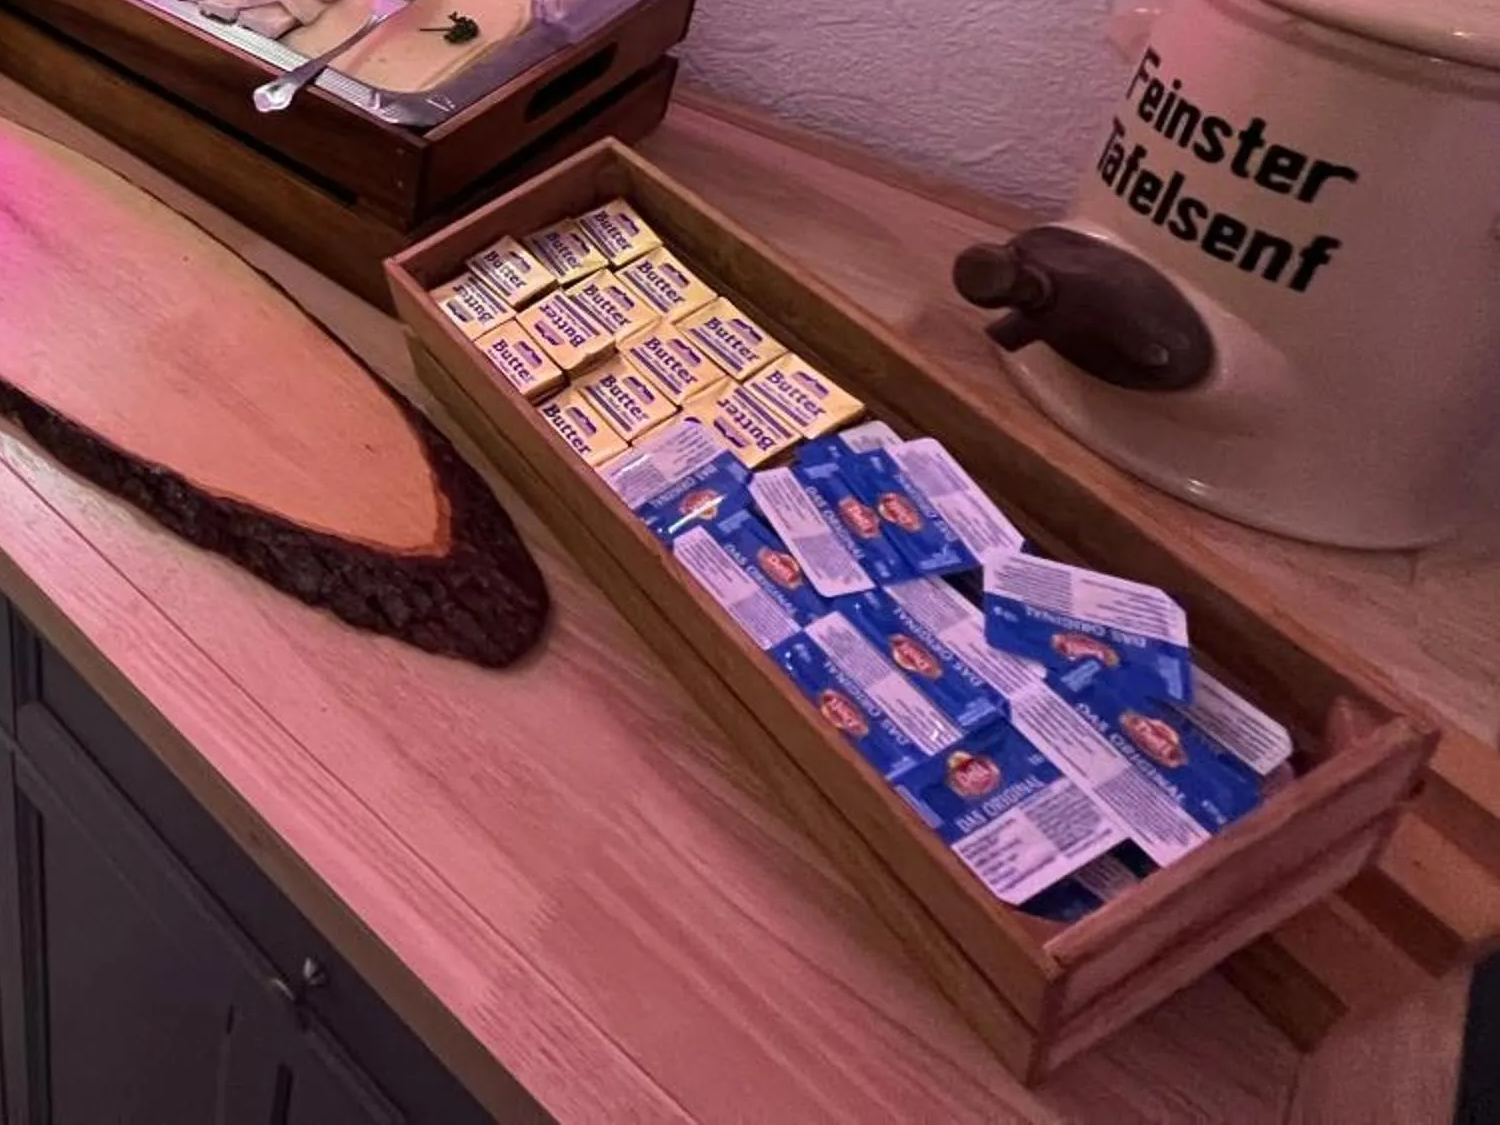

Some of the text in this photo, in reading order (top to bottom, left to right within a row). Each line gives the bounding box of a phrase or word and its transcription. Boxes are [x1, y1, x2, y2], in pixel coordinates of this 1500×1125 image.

[1126, 47, 1359, 203] Feinster
[1097, 115, 1341, 293] Tafelsenf
[594, 211, 633, 250] Butter
[637, 259, 685, 303] Butter
[539, 304, 587, 348] Butter
[583, 283, 632, 326] Butter
[644, 337, 699, 384] Butter
[703, 317, 760, 361] Butter
[599, 374, 650, 420] Butter
[767, 370, 826, 416] Butter
[542, 404, 592, 454] Butter
[717, 399, 776, 451] Butter
